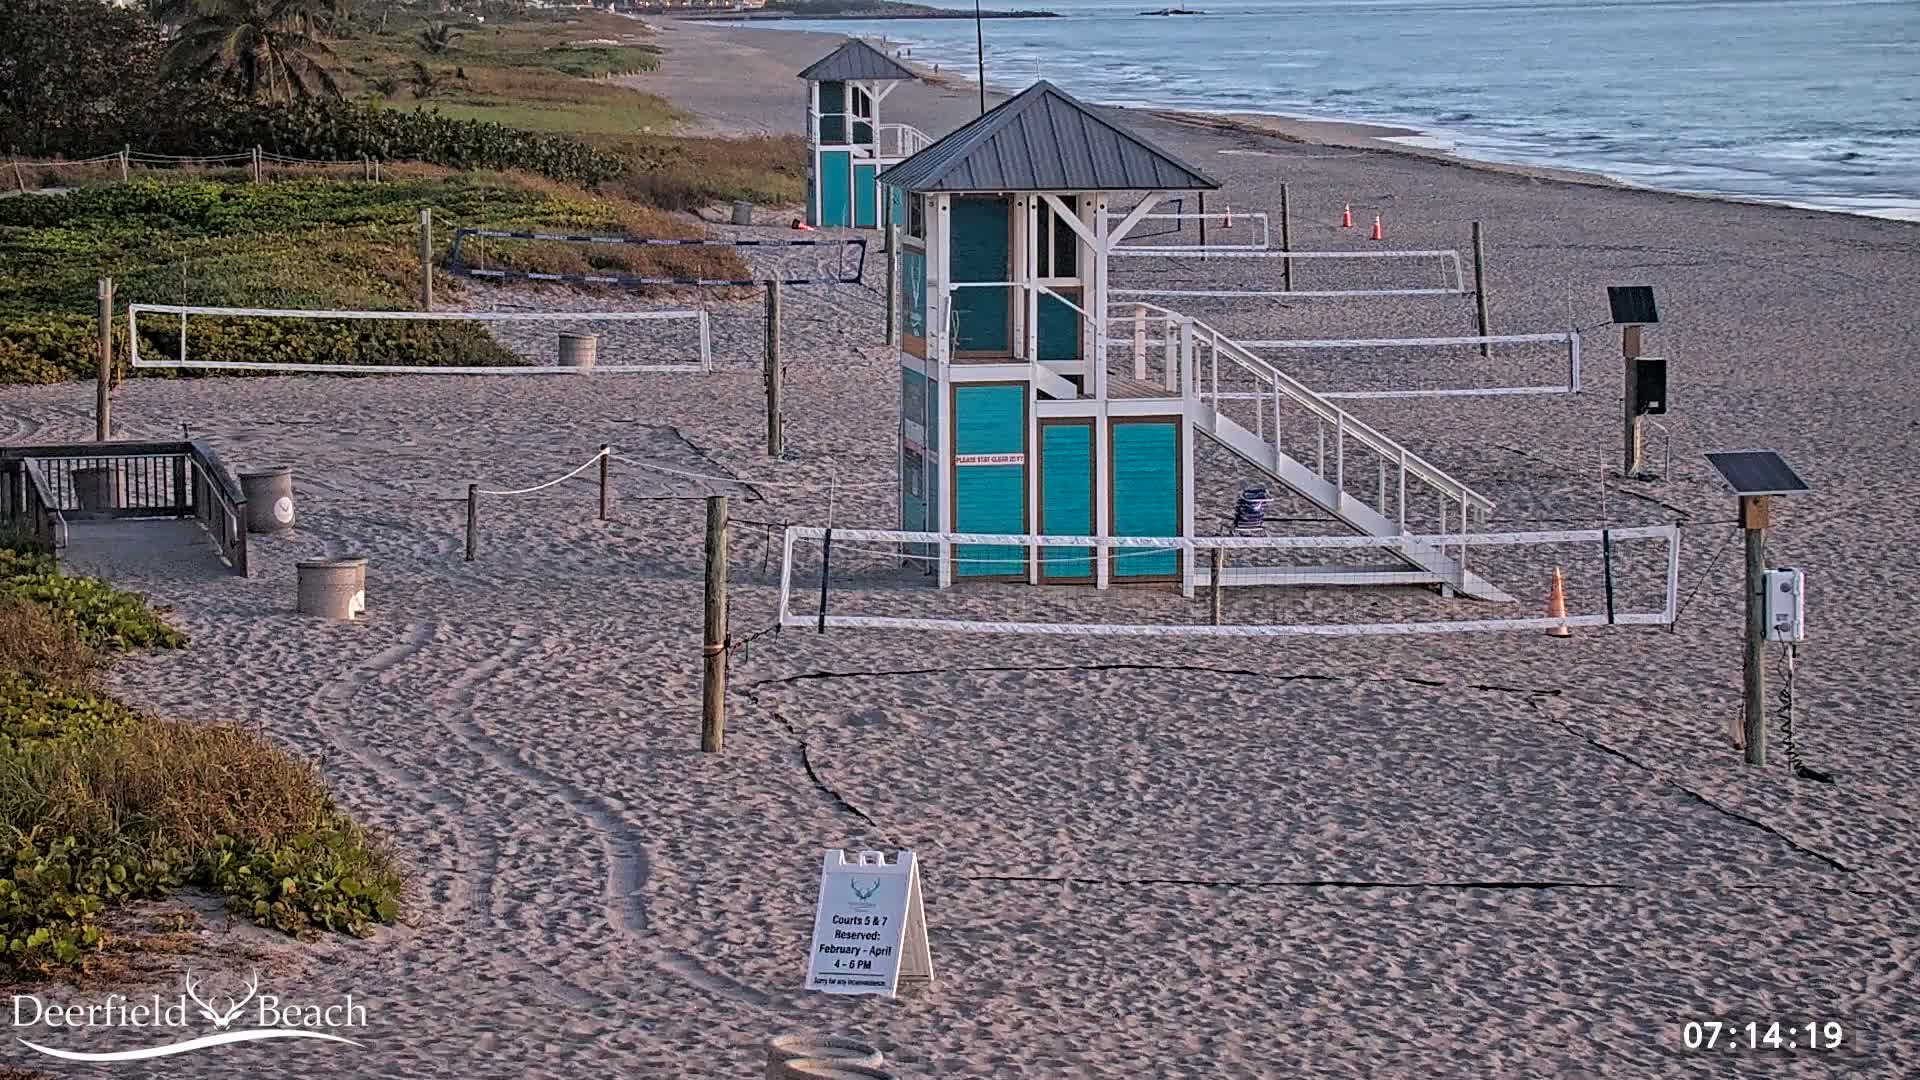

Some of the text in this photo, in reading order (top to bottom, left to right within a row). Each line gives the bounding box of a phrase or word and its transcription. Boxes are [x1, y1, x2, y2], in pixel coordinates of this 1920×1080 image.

[832, 915, 888, 926] Courts 5 & 7
[834, 930, 880, 940] Reserved:
[819, 944, 860, 956] February
[869, 946, 892, 957] April
[834, 960, 840, 968] 4
[849, 960, 855, 969] 6
[857, 960, 872, 969] PM
